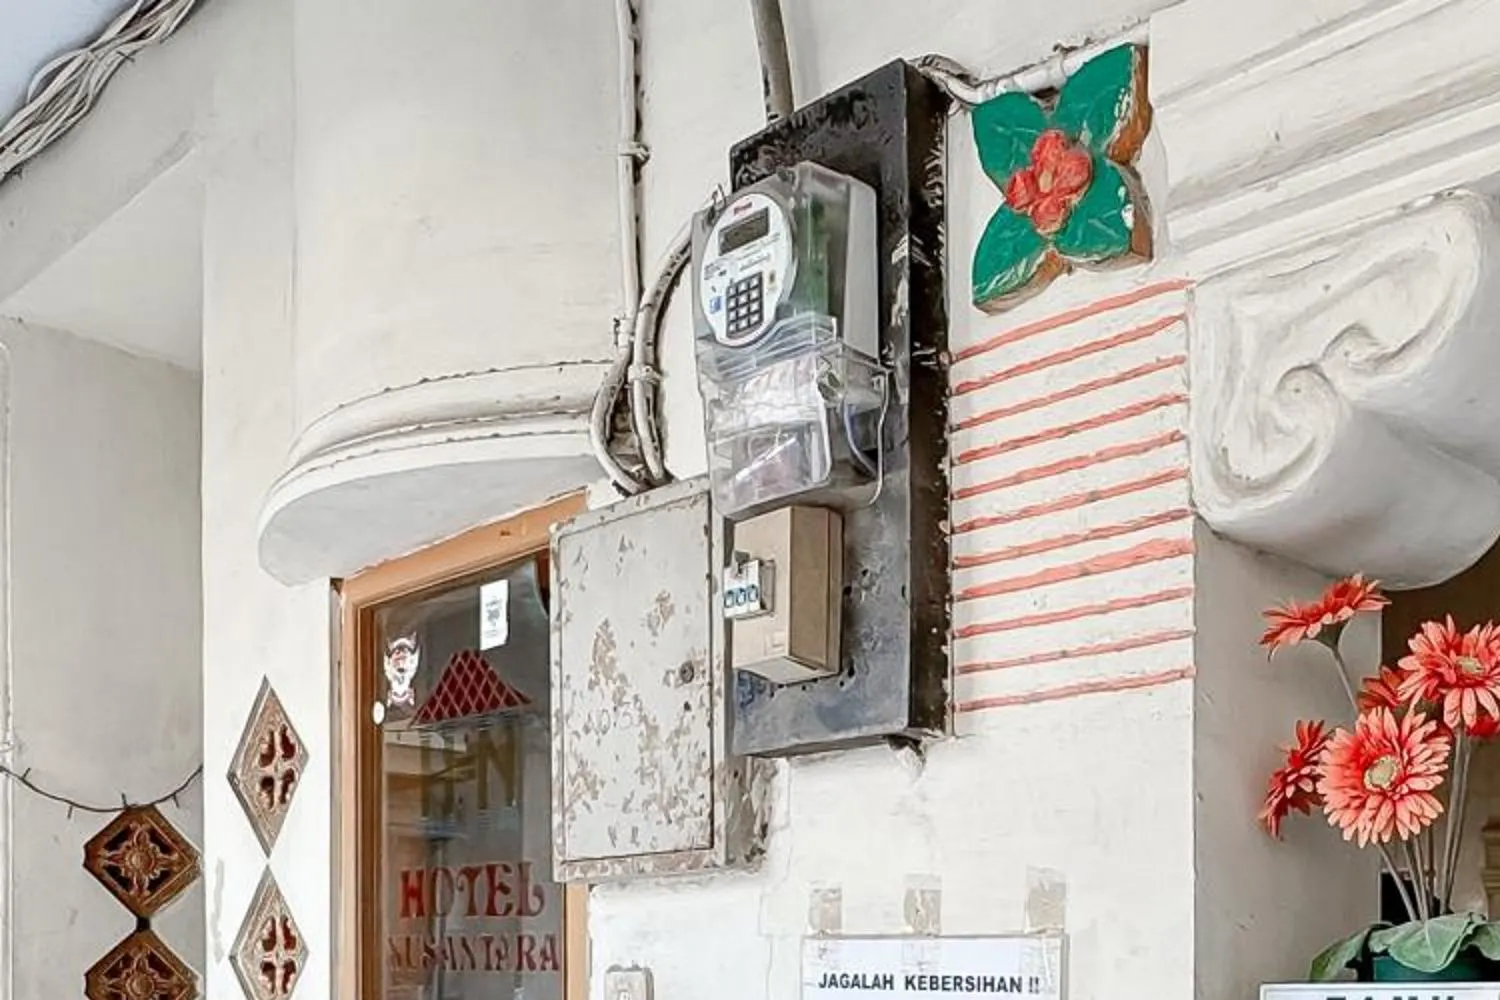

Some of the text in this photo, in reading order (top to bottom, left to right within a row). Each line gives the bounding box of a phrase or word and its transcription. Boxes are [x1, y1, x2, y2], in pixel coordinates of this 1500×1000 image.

[400, 861, 545, 918] HOTEL
[818, 973, 895, 991] JAGALAH
[904, 974, 1023, 994] KEBERSIHAN
